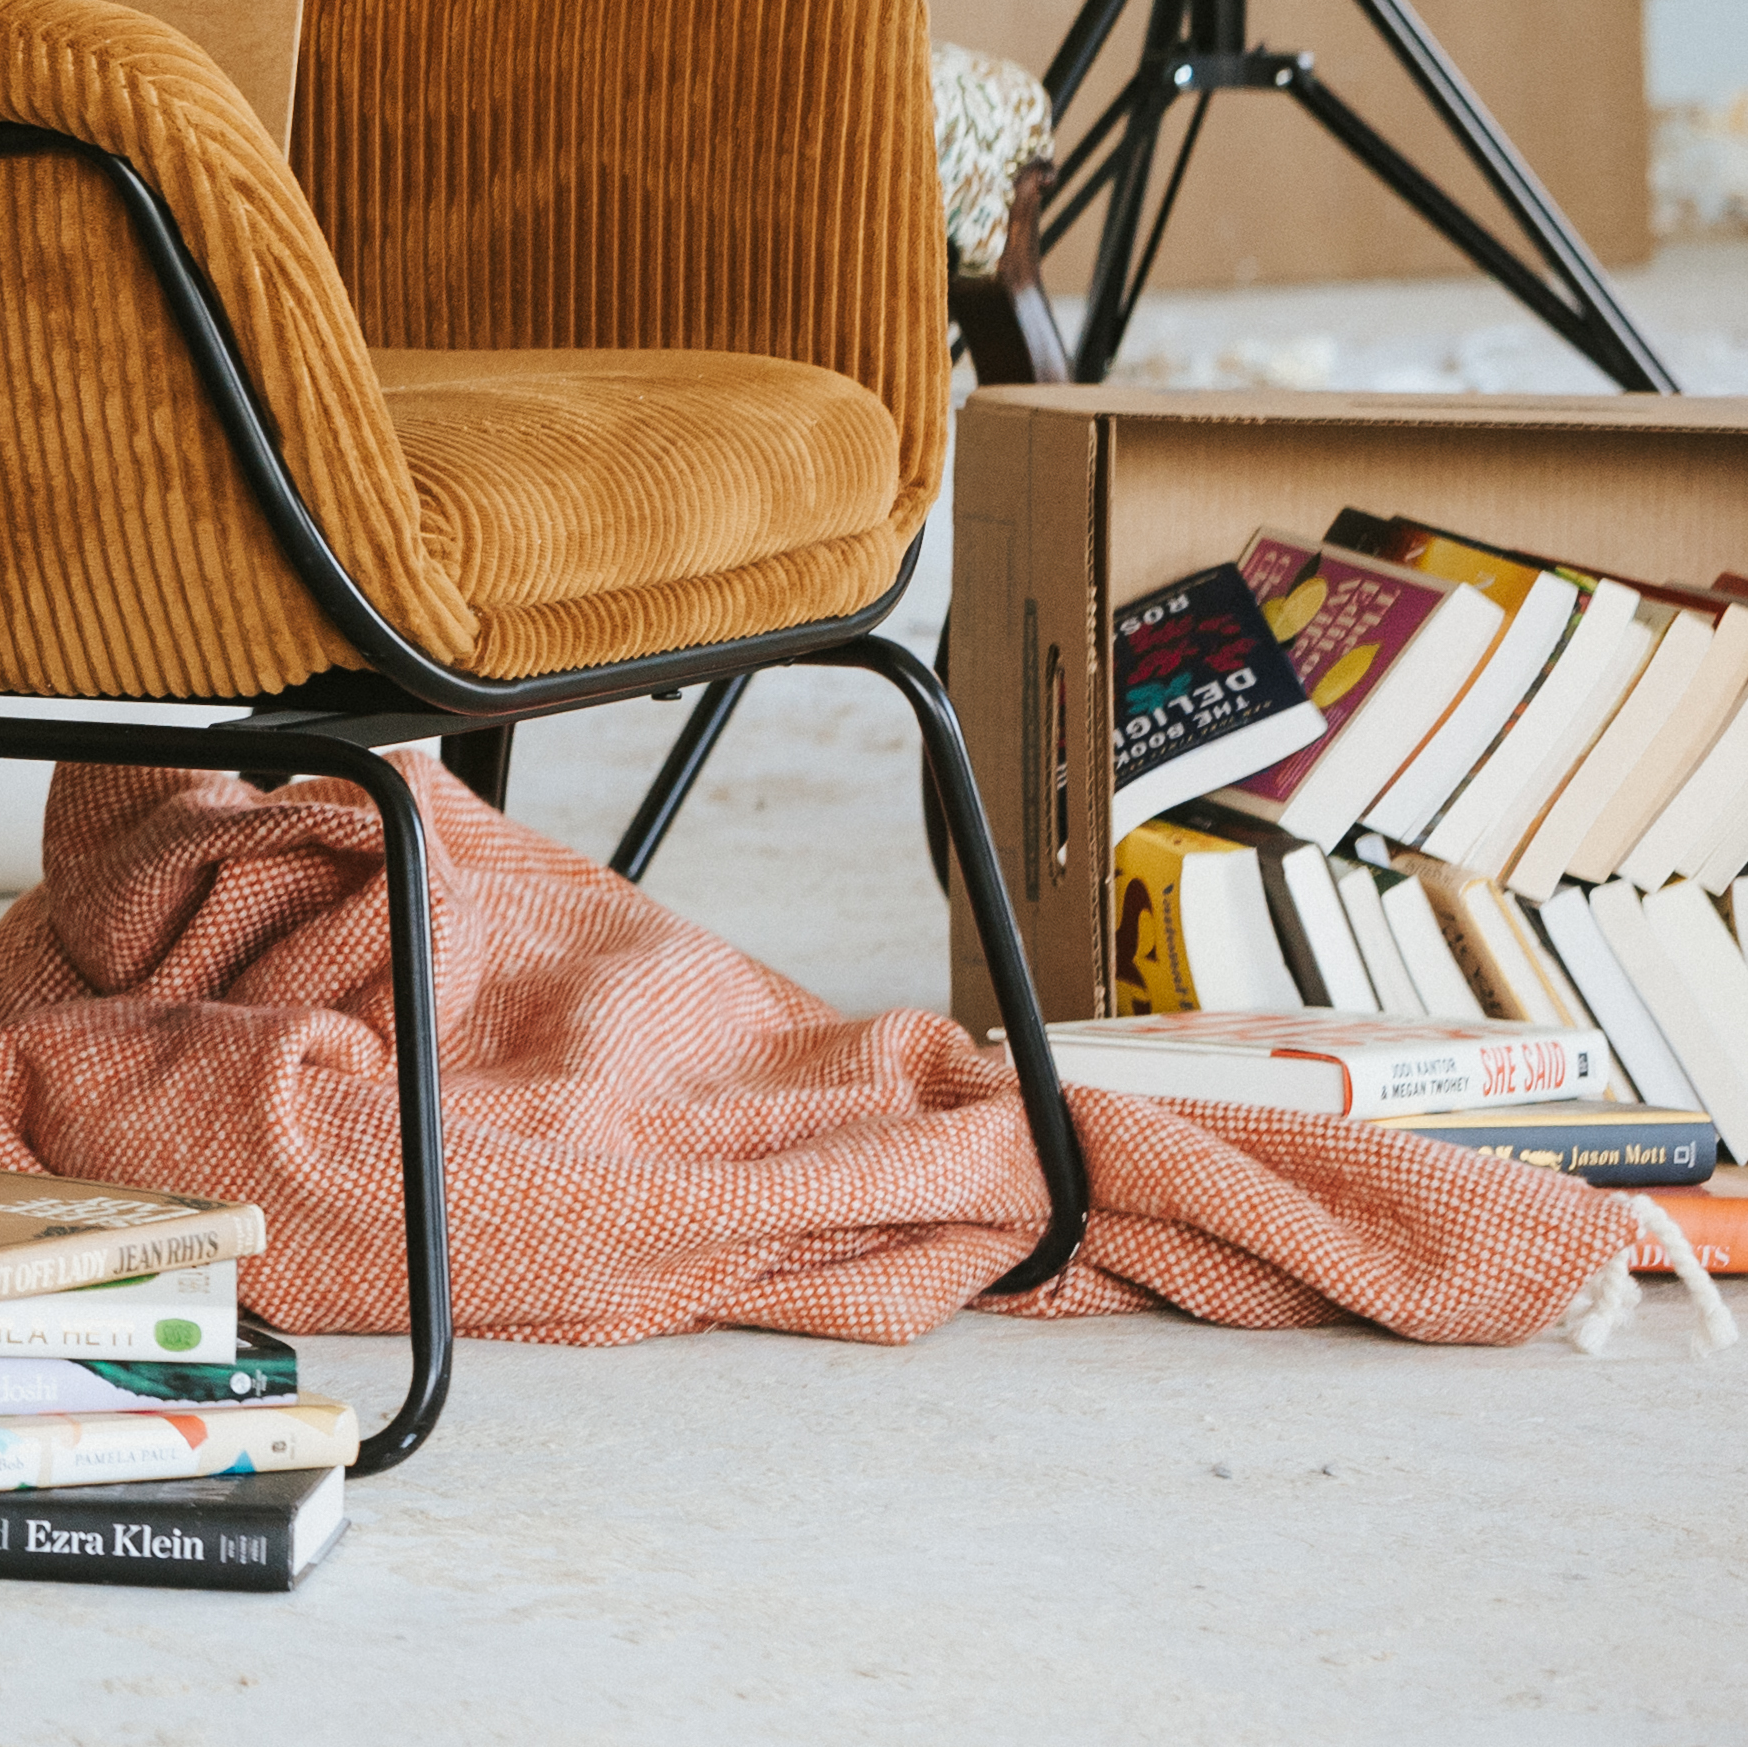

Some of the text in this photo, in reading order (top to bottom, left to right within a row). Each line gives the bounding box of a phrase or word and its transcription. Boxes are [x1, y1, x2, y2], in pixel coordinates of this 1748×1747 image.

[1192, 694, 1251, 729] THE
[1479, 1040, 1567, 1098] SHE SAID
[1391, 1079, 1429, 1100] MEGAN
[1429, 1074, 1471, 1095] TWOHEY
[1567, 1143, 1622, 1173] Jason
[1623, 1142, 1668, 1168] Mott
[14, 1256, 58, 1295] OFF
[58, 1248, 110, 1288] LADY
[112, 1243, 168, 1276] JEAN
[168, 1230, 220, 1266] RHYS
[74, 1451, 138, 1468] PAMELA
[24, 1518, 205, 1561] Ezra Klein
